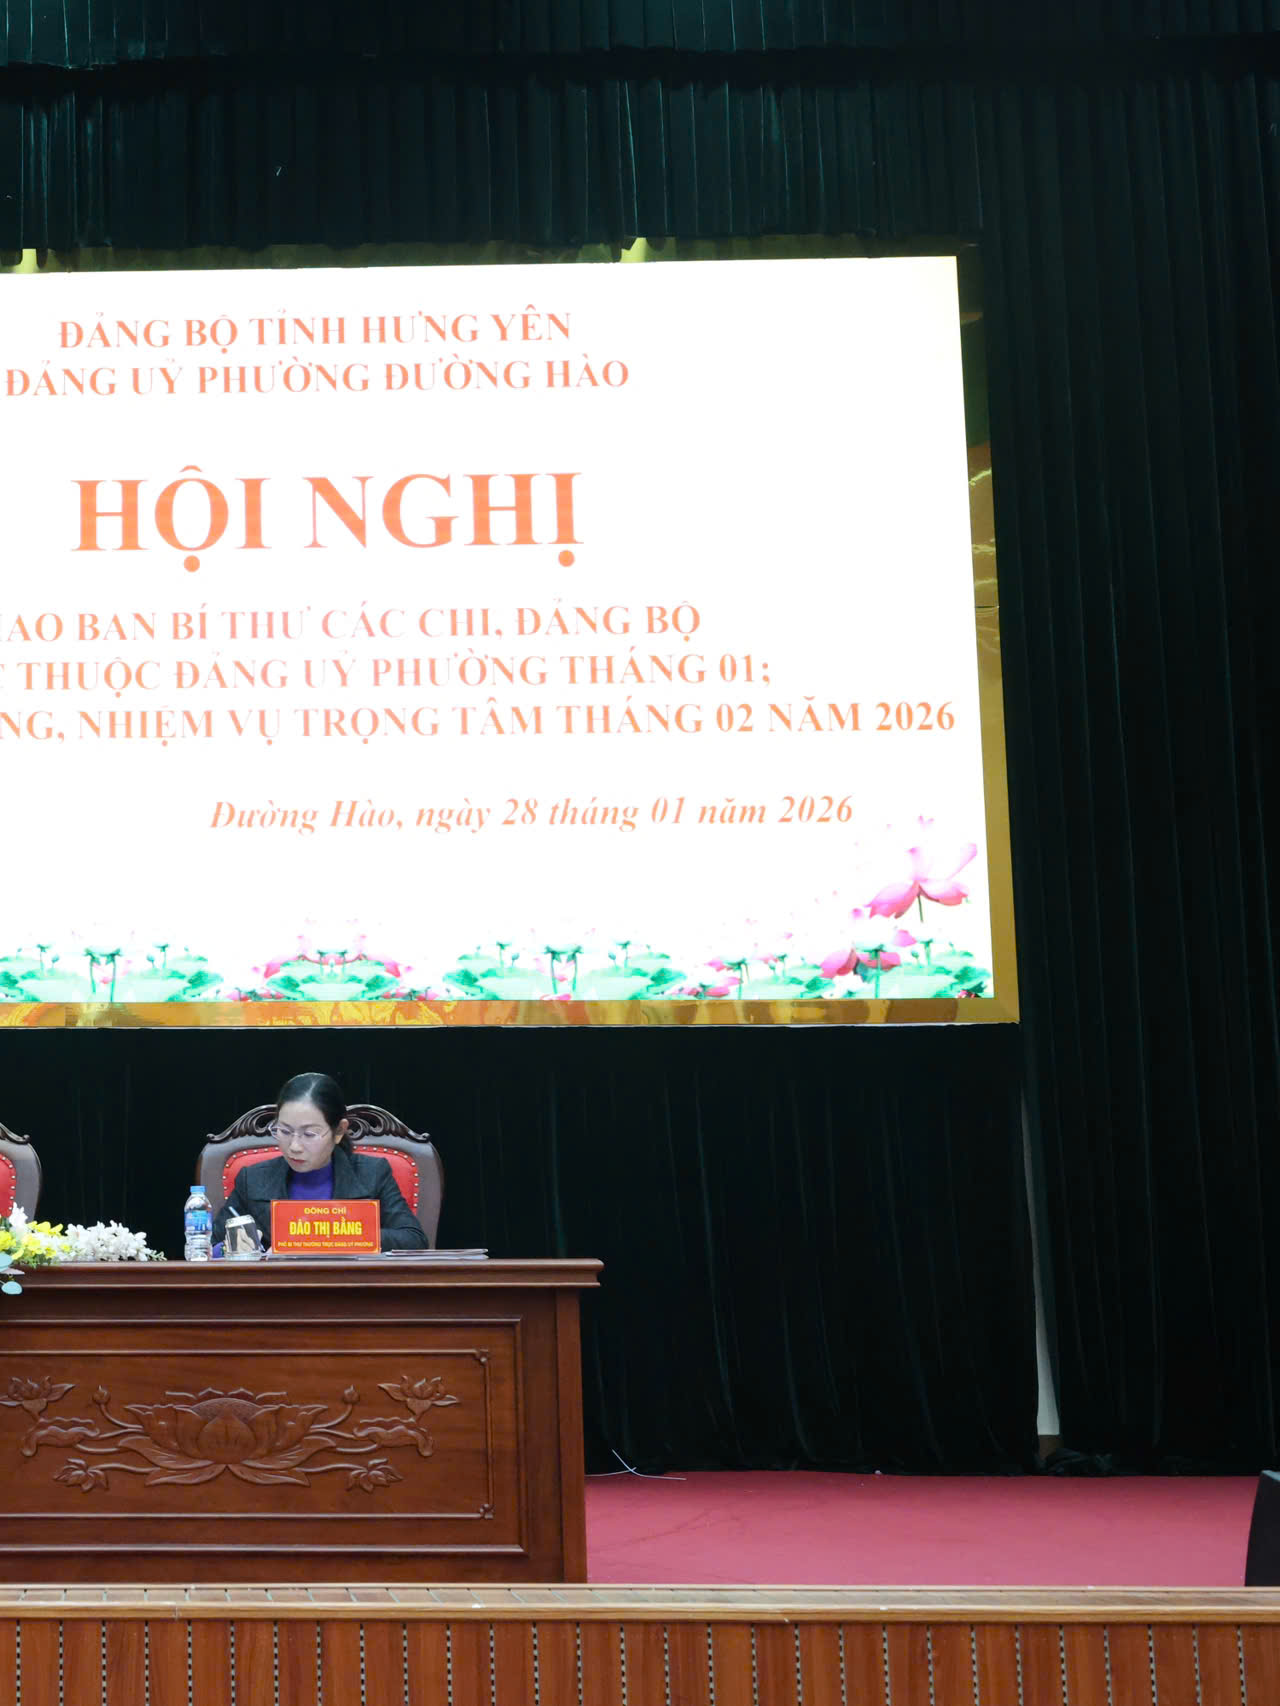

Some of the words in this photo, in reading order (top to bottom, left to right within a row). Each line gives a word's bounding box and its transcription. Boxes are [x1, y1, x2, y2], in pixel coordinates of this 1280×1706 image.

[59, 312, 170, 349] ĐẢNG
[185, 314, 239, 355] BỘ
[248, 308, 346, 346] TỈNH
[362, 310, 479, 344] HƯNG
[489, 303, 570, 342] YÊN
[6, 360, 116, 397] ĐẢNG
[131, 358, 181, 396] UỶ
[199, 354, 369, 395] PHƯỜNG
[384, 353, 531, 392] ĐƯỜNG
[545, 352, 630, 389] HÀO
[72, 464, 271, 574] HỘI
[303, 472, 584, 568] NGHỊ
[77, 612, 156, 641] BAN
[172, 602, 208, 641] BÍ
[221, 605, 311, 640] THƯ
[321, 603, 405, 638] CÁC
[418, 608, 504, 639] CHI,
[517, 598, 631, 636] ĐẢNG
[645, 600, 701, 643] BỘ
[16, 657, 160, 699] THUỘC
[175, 651, 288, 689] ĐẢNG
[304, 650, 355, 689] UỶ
[372, 651, 547, 687] PHƯỜNG
[560, 645, 706, 685] THÁNG
[719, 653, 771, 685] 01;
[79, 705, 213, 748] NHIỆM
[227, 708, 280, 747] VỤ
[294, 707, 440, 745] TRỌNG
[451, 696, 544, 736] TÂM
[555, 695, 703, 735] THÁNG
[715, 703, 753, 733] 02
[768, 695, 861, 733] NĂM
[875, 701, 956, 732] 2026
[210, 799, 320, 835] Đường
[330, 799, 404, 831] Hào,
[415, 797, 492, 834] ngày
[501, 798, 539, 826] 28
[548, 796, 639, 832] tháng
[651, 796, 686, 824] 01
[697, 797, 767, 825] năm
[777, 794, 853, 824] 2026
[313, 1221, 330, 1238] THỊ
[333, 1216, 362, 1235] BẰNG
